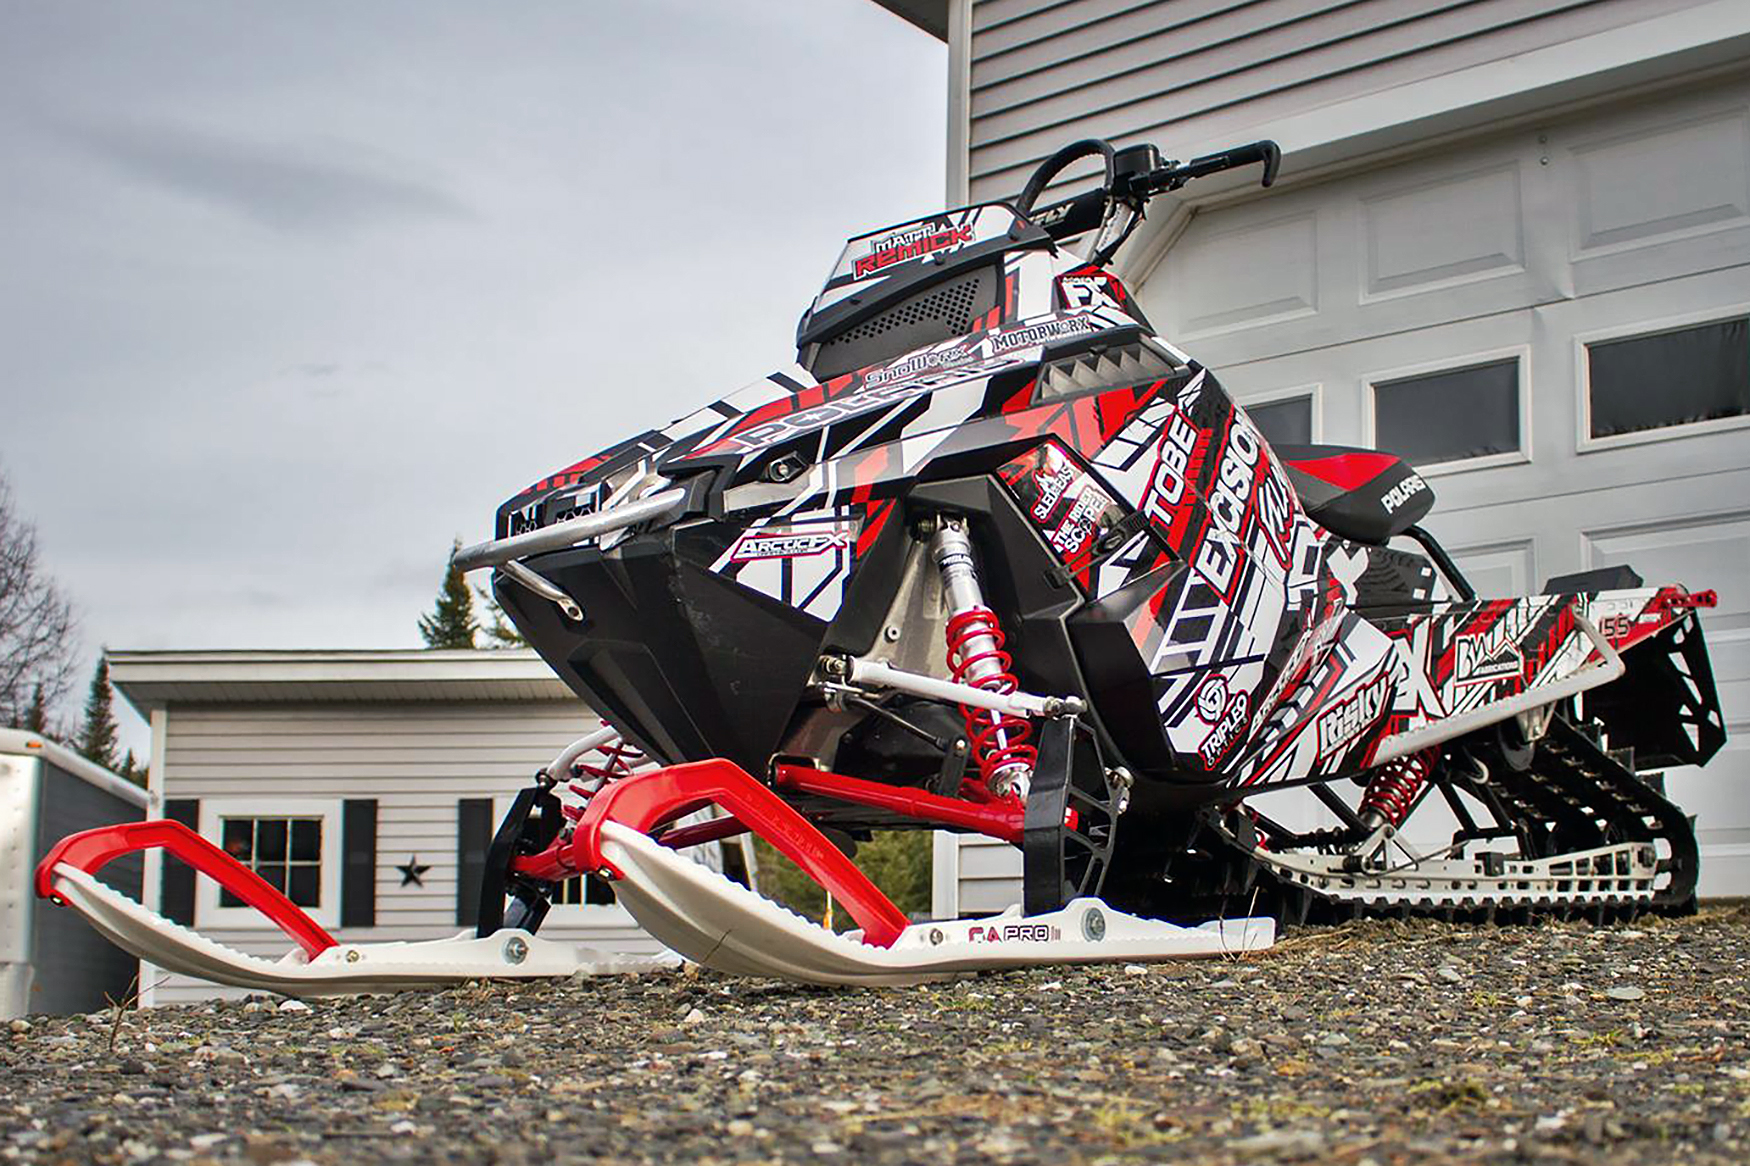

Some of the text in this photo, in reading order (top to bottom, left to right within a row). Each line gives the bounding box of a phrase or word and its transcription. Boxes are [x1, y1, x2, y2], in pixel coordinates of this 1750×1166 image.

[855, 224, 973, 277] REMICK
[1145, 414, 1197, 524] TOBE
[1381, 475, 1426, 514] POLARIS
[1053, 519, 1075, 545] THE
[1004, 925, 1049, 942] PRO
